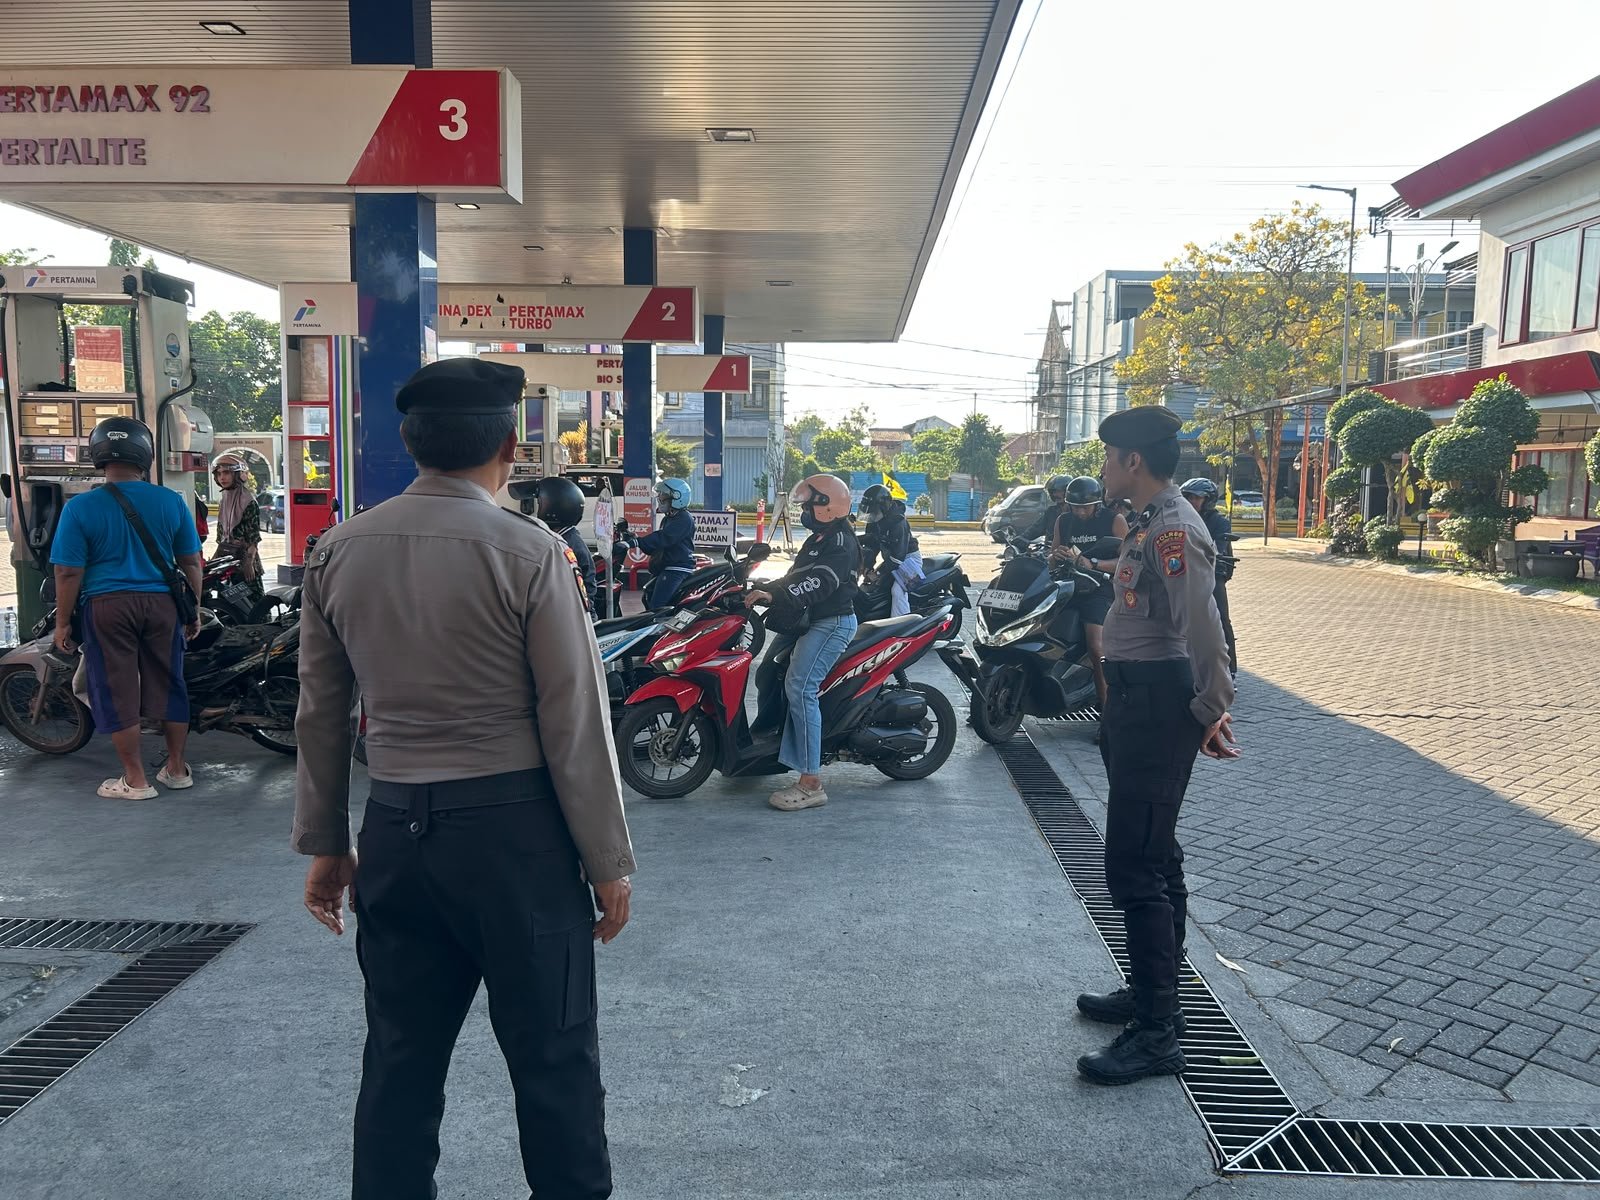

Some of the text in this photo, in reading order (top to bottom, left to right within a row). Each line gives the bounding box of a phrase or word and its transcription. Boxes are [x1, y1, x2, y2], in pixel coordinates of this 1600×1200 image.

[168, 84, 210, 112] 92
[438, 98, 469, 141] 3
[0, 137, 147, 166] ERTALITE
[50, 276, 96, 284] PERTAMINA
[438, 304, 585, 318] INA DEX PERTAMAX
[661, 301, 676, 321] 2
[509, 317, 552, 330] TURBO
[731, 363, 737, 377] 1
[596, 374, 613, 384] BIO
[787, 575, 821, 597] Grab
[727, 657, 748, 670] HONDA
